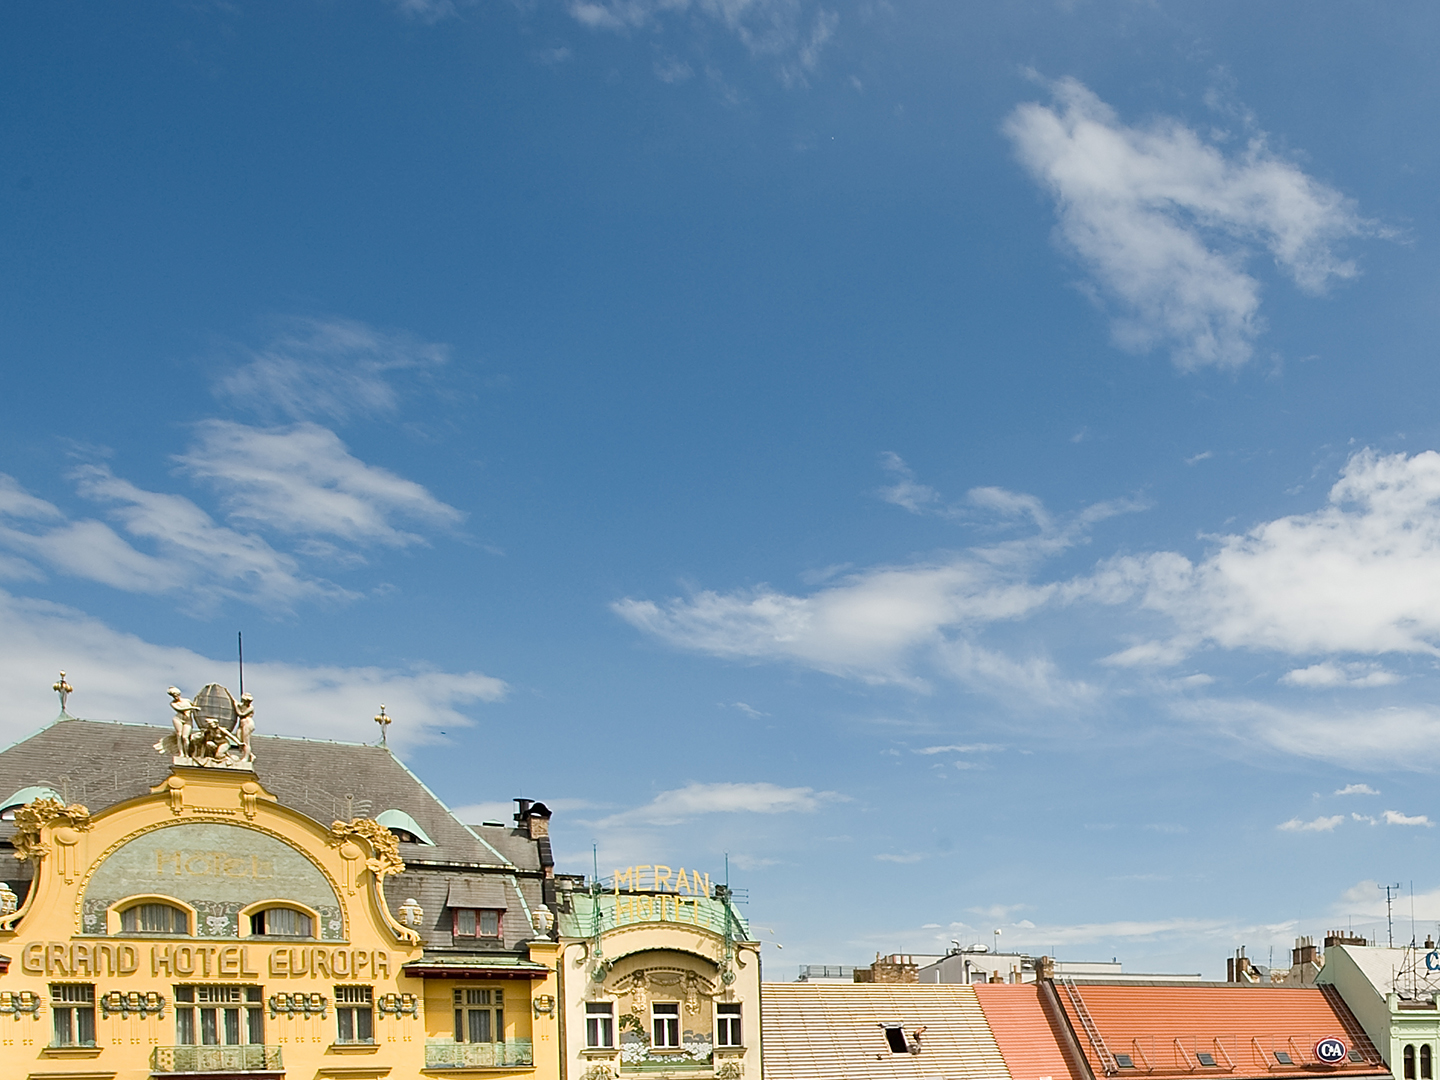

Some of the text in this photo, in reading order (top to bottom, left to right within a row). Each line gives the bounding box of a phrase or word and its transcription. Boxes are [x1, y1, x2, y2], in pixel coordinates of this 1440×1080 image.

[614, 864, 710, 898] MERAN
[615, 894, 710, 928] HOTEL
[22, 940, 393, 980] GRAND HOTEL EUROPA
[1321, 1043, 1343, 1057] C&A
